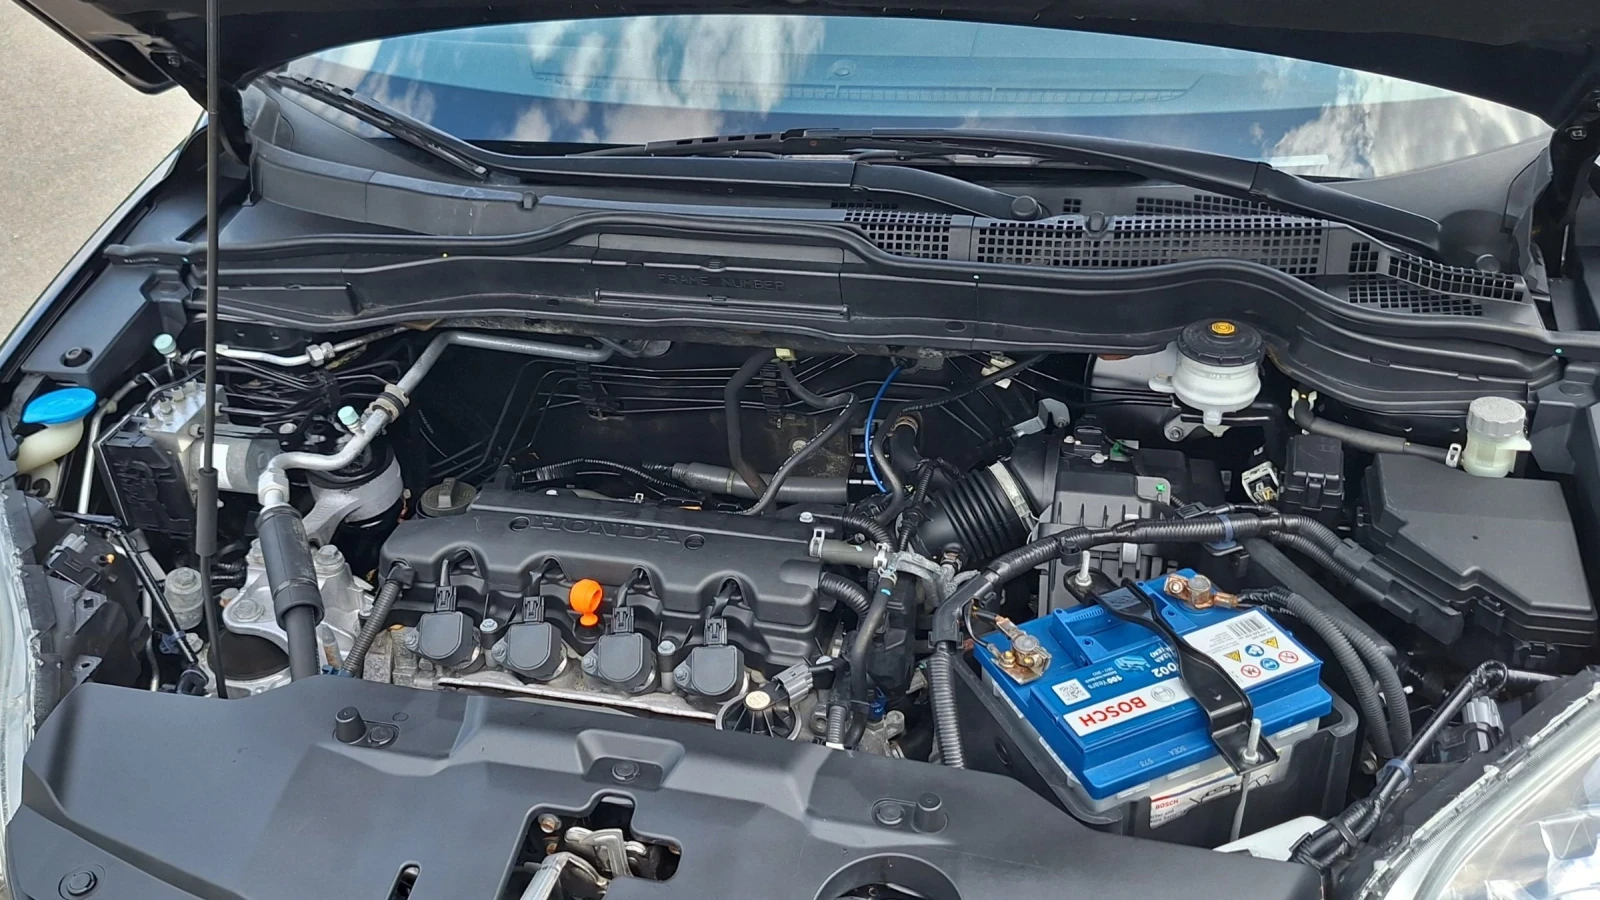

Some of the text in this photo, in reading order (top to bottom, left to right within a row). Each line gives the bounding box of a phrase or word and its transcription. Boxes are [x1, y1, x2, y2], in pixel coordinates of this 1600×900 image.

[657, 273, 785, 290] FRAME NUMBER
[530, 515, 681, 544] HONDA
[1087, 675, 1122, 690] 100 Years
[1078, 696, 1147, 727] BOSCH
[1155, 799, 1179, 810] BOSCH
